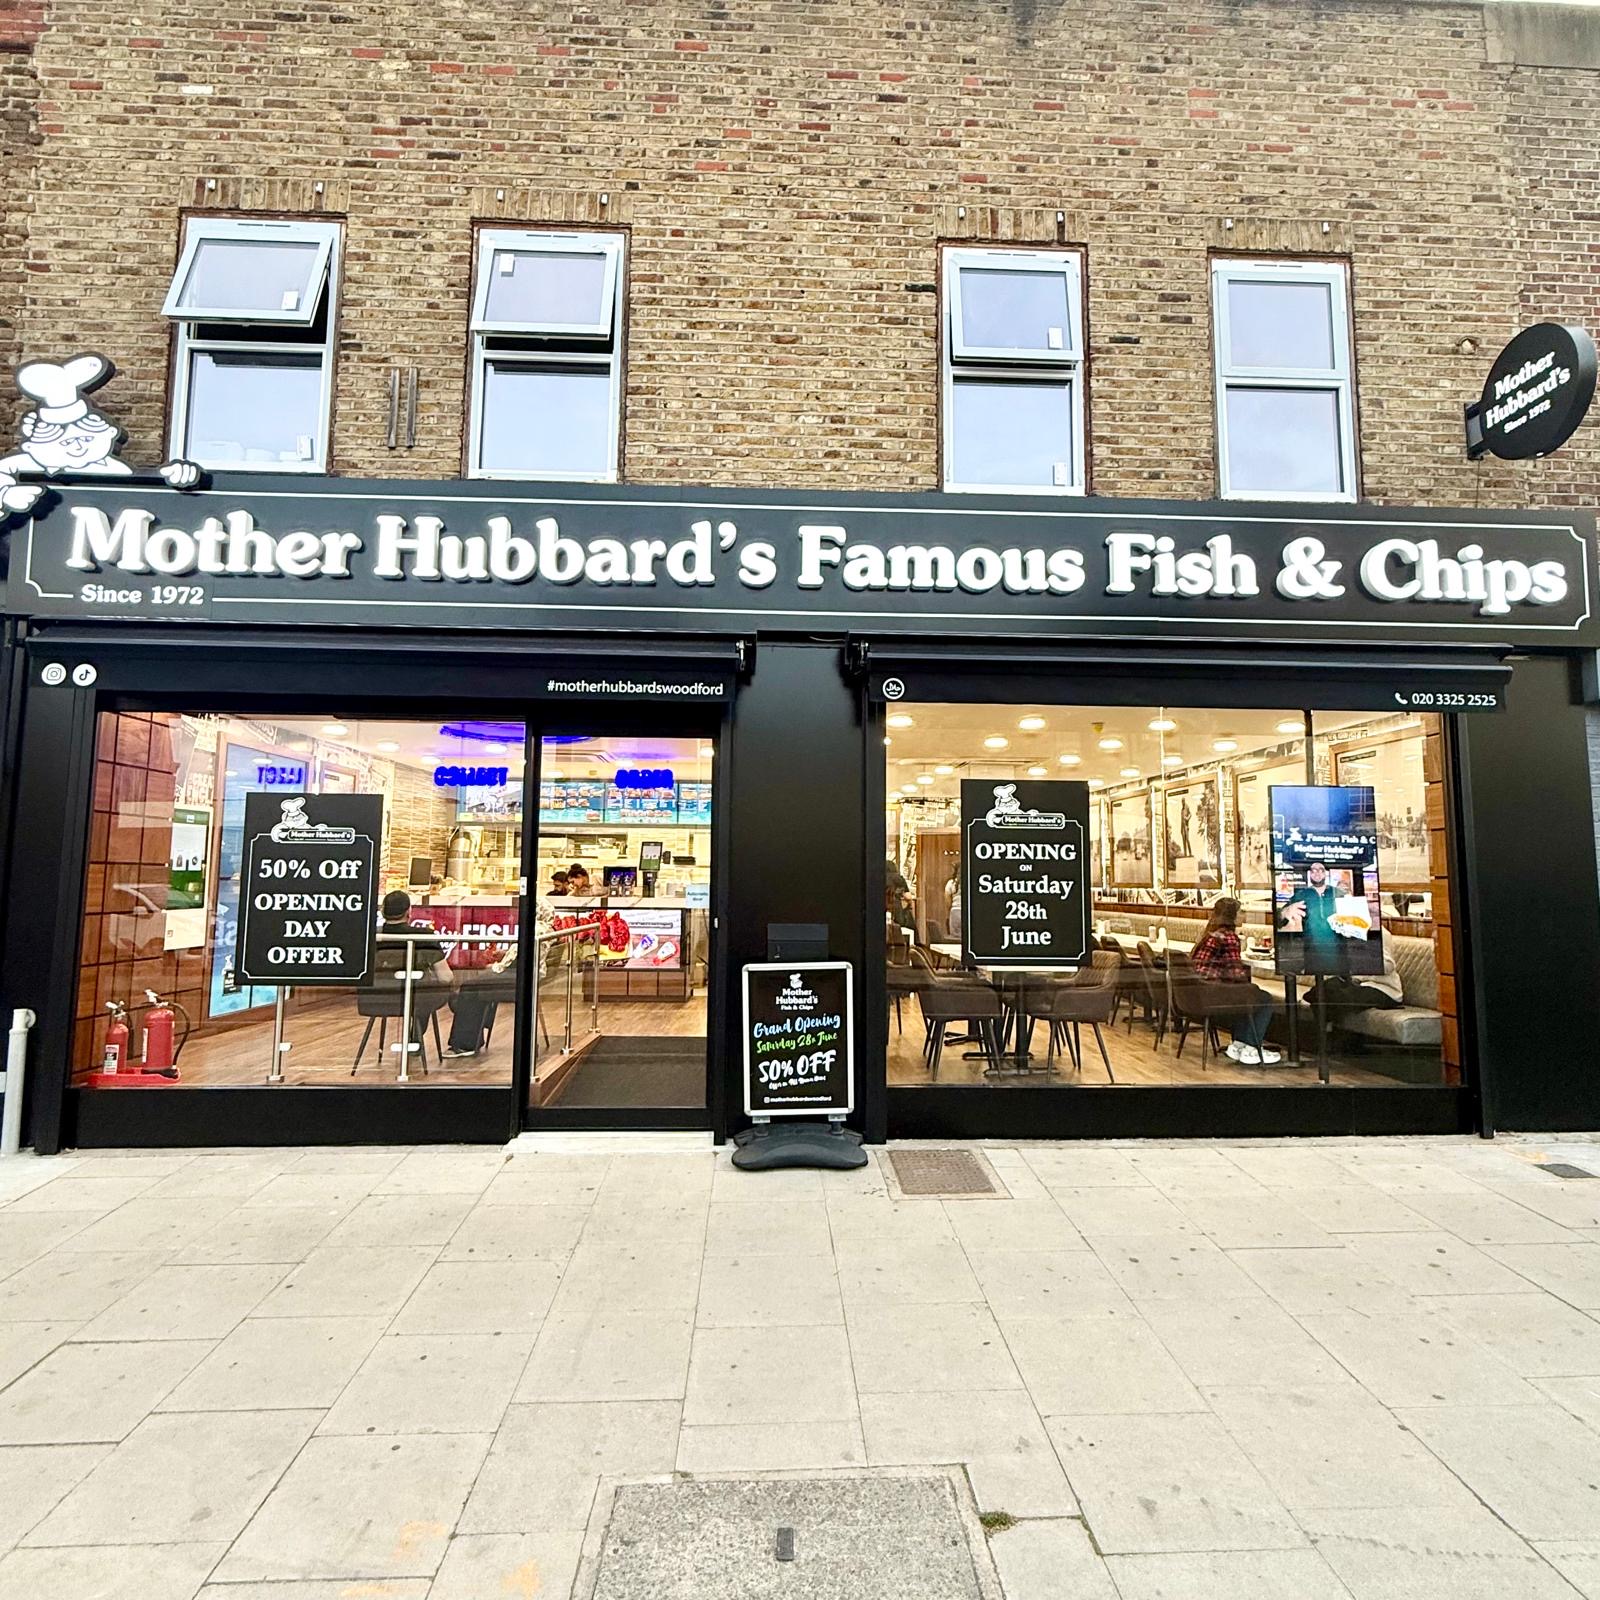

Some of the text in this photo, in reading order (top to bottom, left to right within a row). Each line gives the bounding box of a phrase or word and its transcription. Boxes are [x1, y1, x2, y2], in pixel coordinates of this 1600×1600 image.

[1494, 351, 1555, 400] Mother
[1485, 367, 1571, 429] Hubbard's
[66, 506, 1568, 617] Mother Hubbard's Famous Fish & Chips
[80, 583, 204, 606] Since 1972
[547, 680, 724, 696] #motherhubbardswoodford
[1411, 693, 1497, 706] 020 3325 2525
[975, 843, 1077, 860] OPENING
[258, 859, 362, 880] 50% Off
[1019, 864, 1033, 872] ON
[978, 875, 1074, 900] Saturday
[254, 893, 363, 912] OPENING
[1005, 901, 1048, 920] 28th
[284, 920, 330, 939] DAY
[1001, 926, 1052, 949] June
[267, 946, 344, 965] OFFER
[775, 996, 819, 1005] Hubbard's
[782, 988, 813, 996] Mother
[753, 1013, 841, 1038] Grand Opening
[756, 1038, 796, 1054] Saturday
[816, 1031, 838, 1046] June
[758, 1060, 794, 1083] 50%
[796, 1049, 837, 1076] OFF
